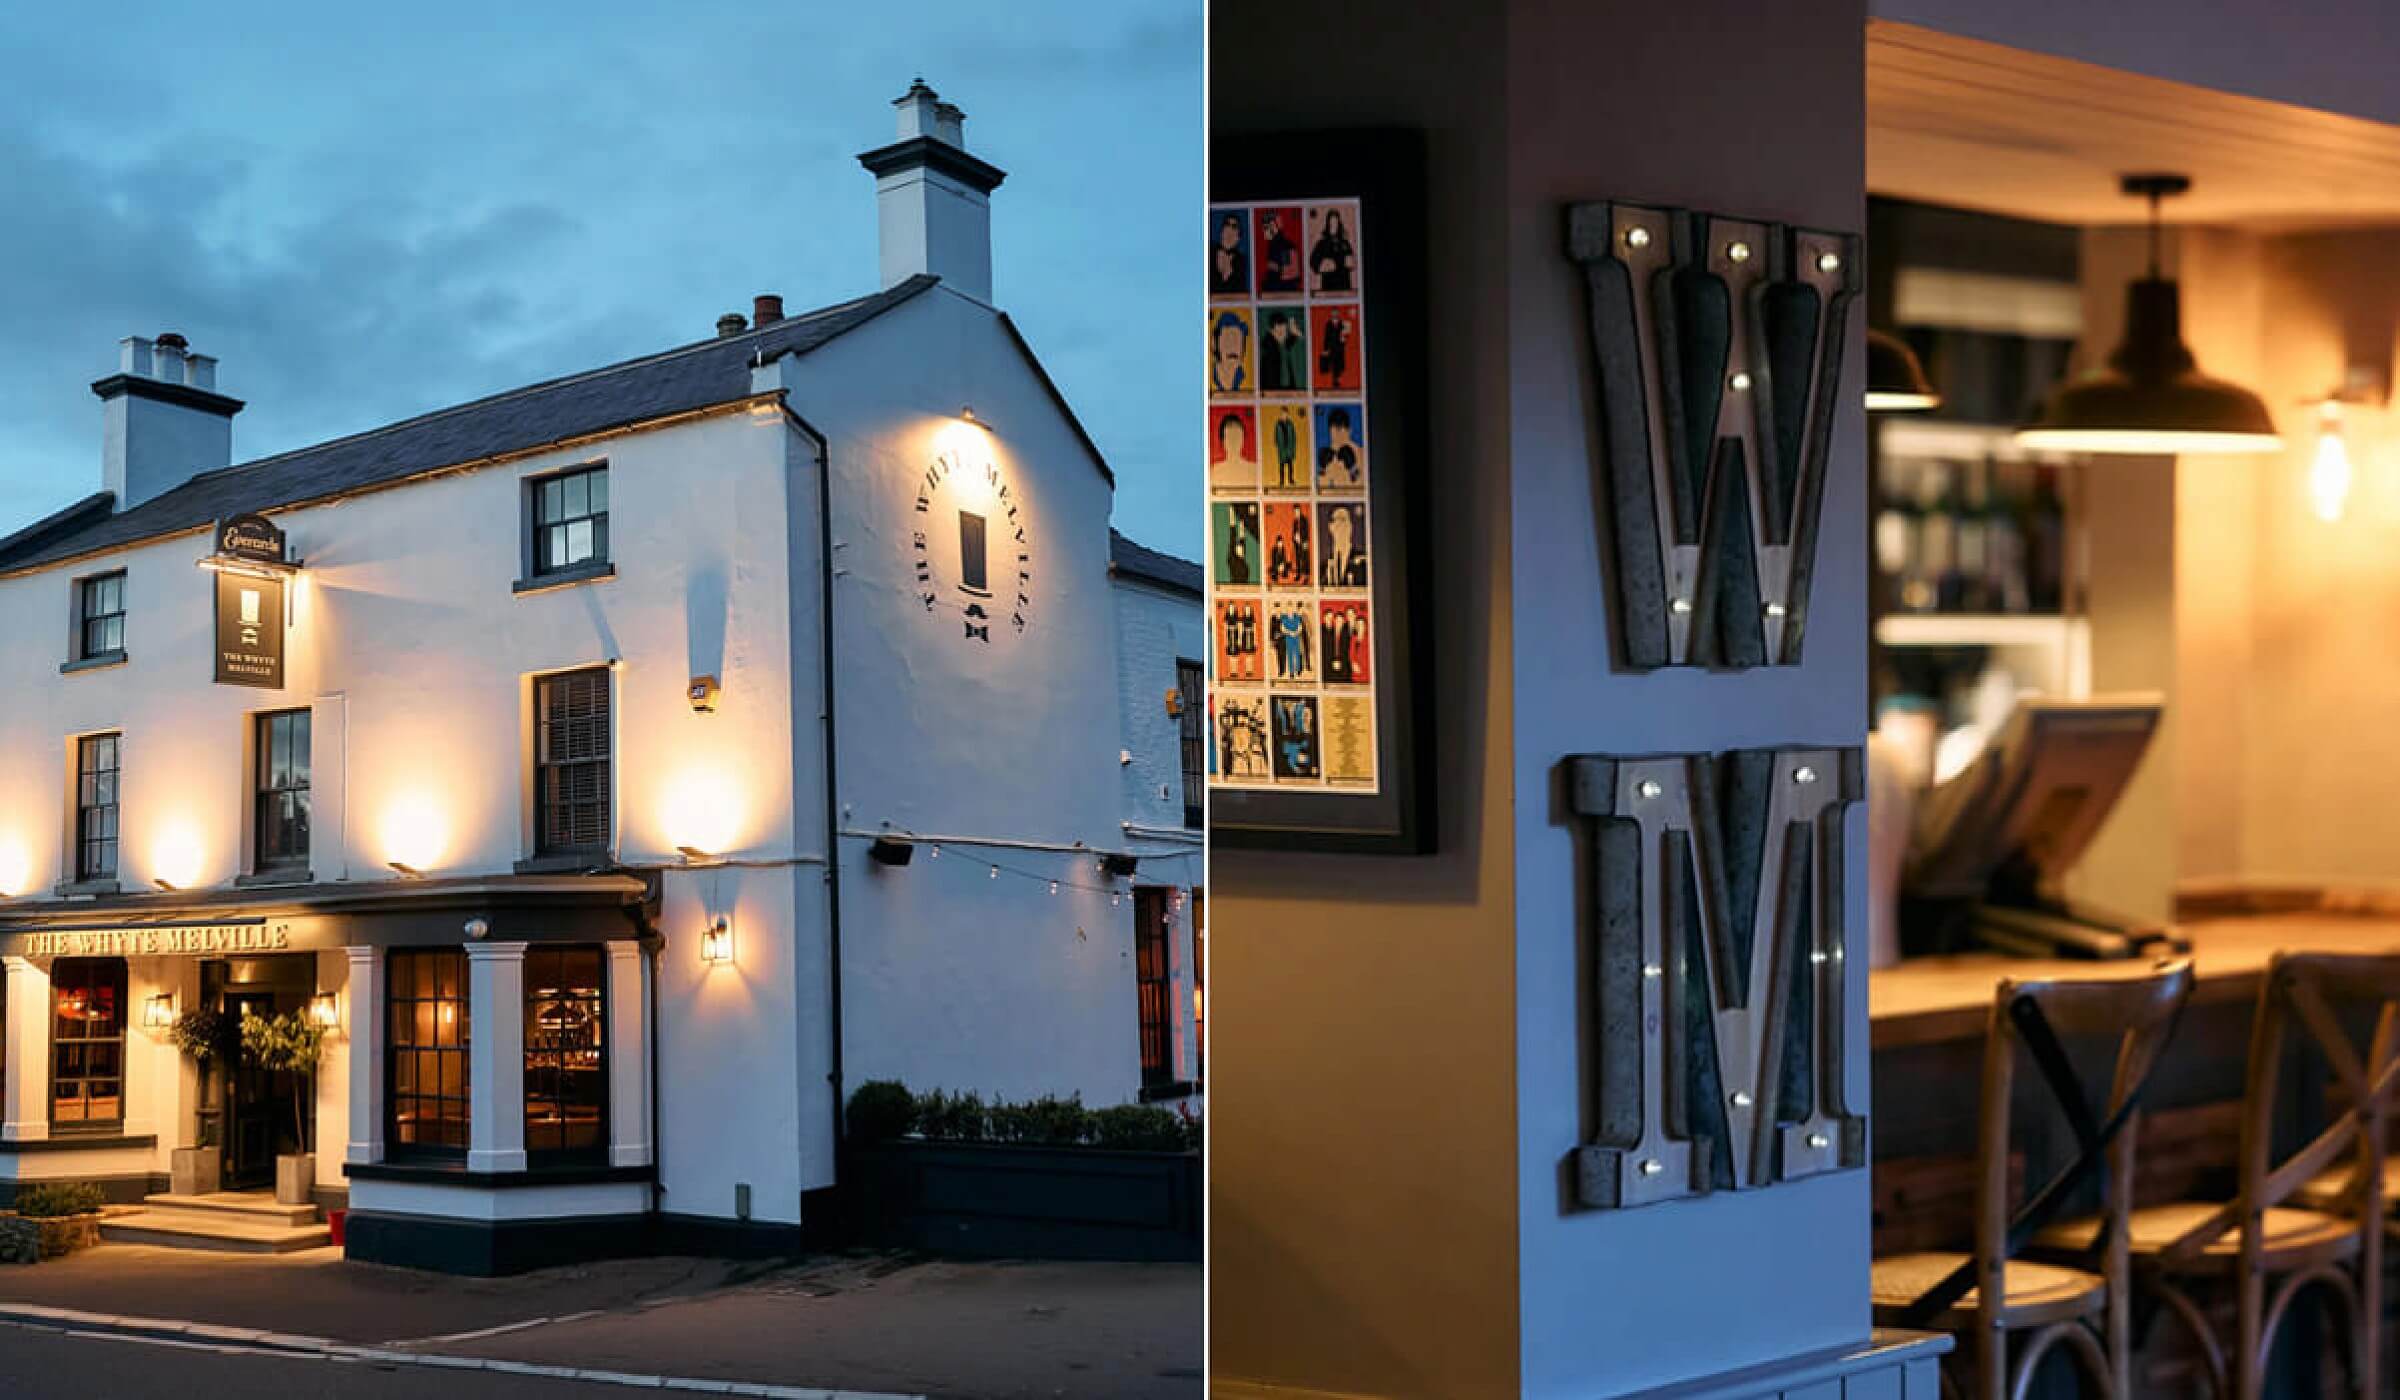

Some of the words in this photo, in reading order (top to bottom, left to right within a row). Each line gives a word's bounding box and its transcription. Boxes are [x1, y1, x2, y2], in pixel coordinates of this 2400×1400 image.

[1569, 201, 1862, 669] W
[915, 449, 962, 512] WHYT
[914, 532, 936, 612] THE
[986, 463, 1029, 633] MELVILLE
[223, 652, 242, 662] THE
[244, 654, 277, 665] WHYTE
[227, 663, 272, 675] MELVILLE
[26, 932, 68, 955] THE
[79, 929, 160, 954] WHYTE
[167, 924, 289, 953] MELVILLE
[1569, 746, 1866, 1208] M
